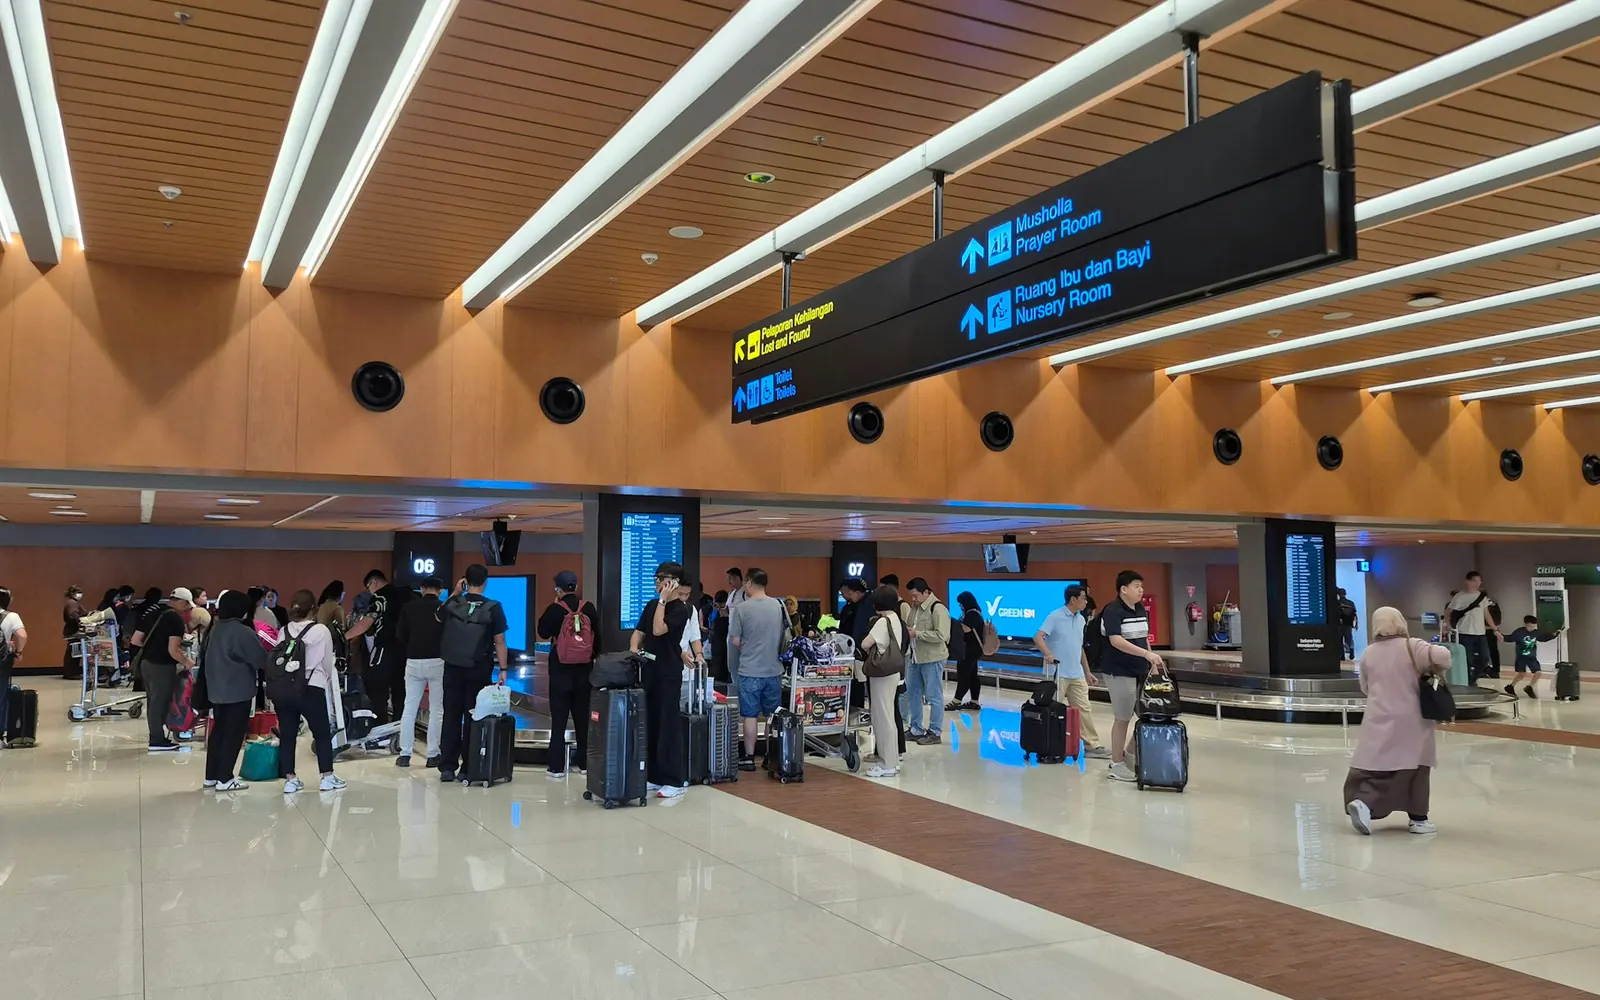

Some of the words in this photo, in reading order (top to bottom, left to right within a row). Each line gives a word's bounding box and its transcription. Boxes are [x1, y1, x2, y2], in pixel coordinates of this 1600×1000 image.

[1016, 197, 1073, 234] Musholla
[1016, 228, 1057, 256] Prayer
[1060, 209, 1102, 238] Room
[1015, 278, 1056, 304] Ruang
[1060, 268, 1081, 289] Ibu
[1085, 258, 1112, 280] dan
[1116, 240, 1151, 270] Bayi
[1015, 297, 1066, 326] Nursery
[1069, 283, 1112, 309] Room
[761, 318, 794, 340] Pelaporan
[794, 301, 834, 326] Kehilangan
[761, 340, 775, 355] Lost
[775, 336, 788, 347] and
[788, 324, 811, 345] Found
[775, 368, 793, 385] Toilet
[775, 384, 797, 400] Toilets
[413, 558, 435, 574] 06
[848, 562, 864, 576] 07
[1537, 566, 1566, 574] Citilink
[998, 608, 1023, 618] GREEN
